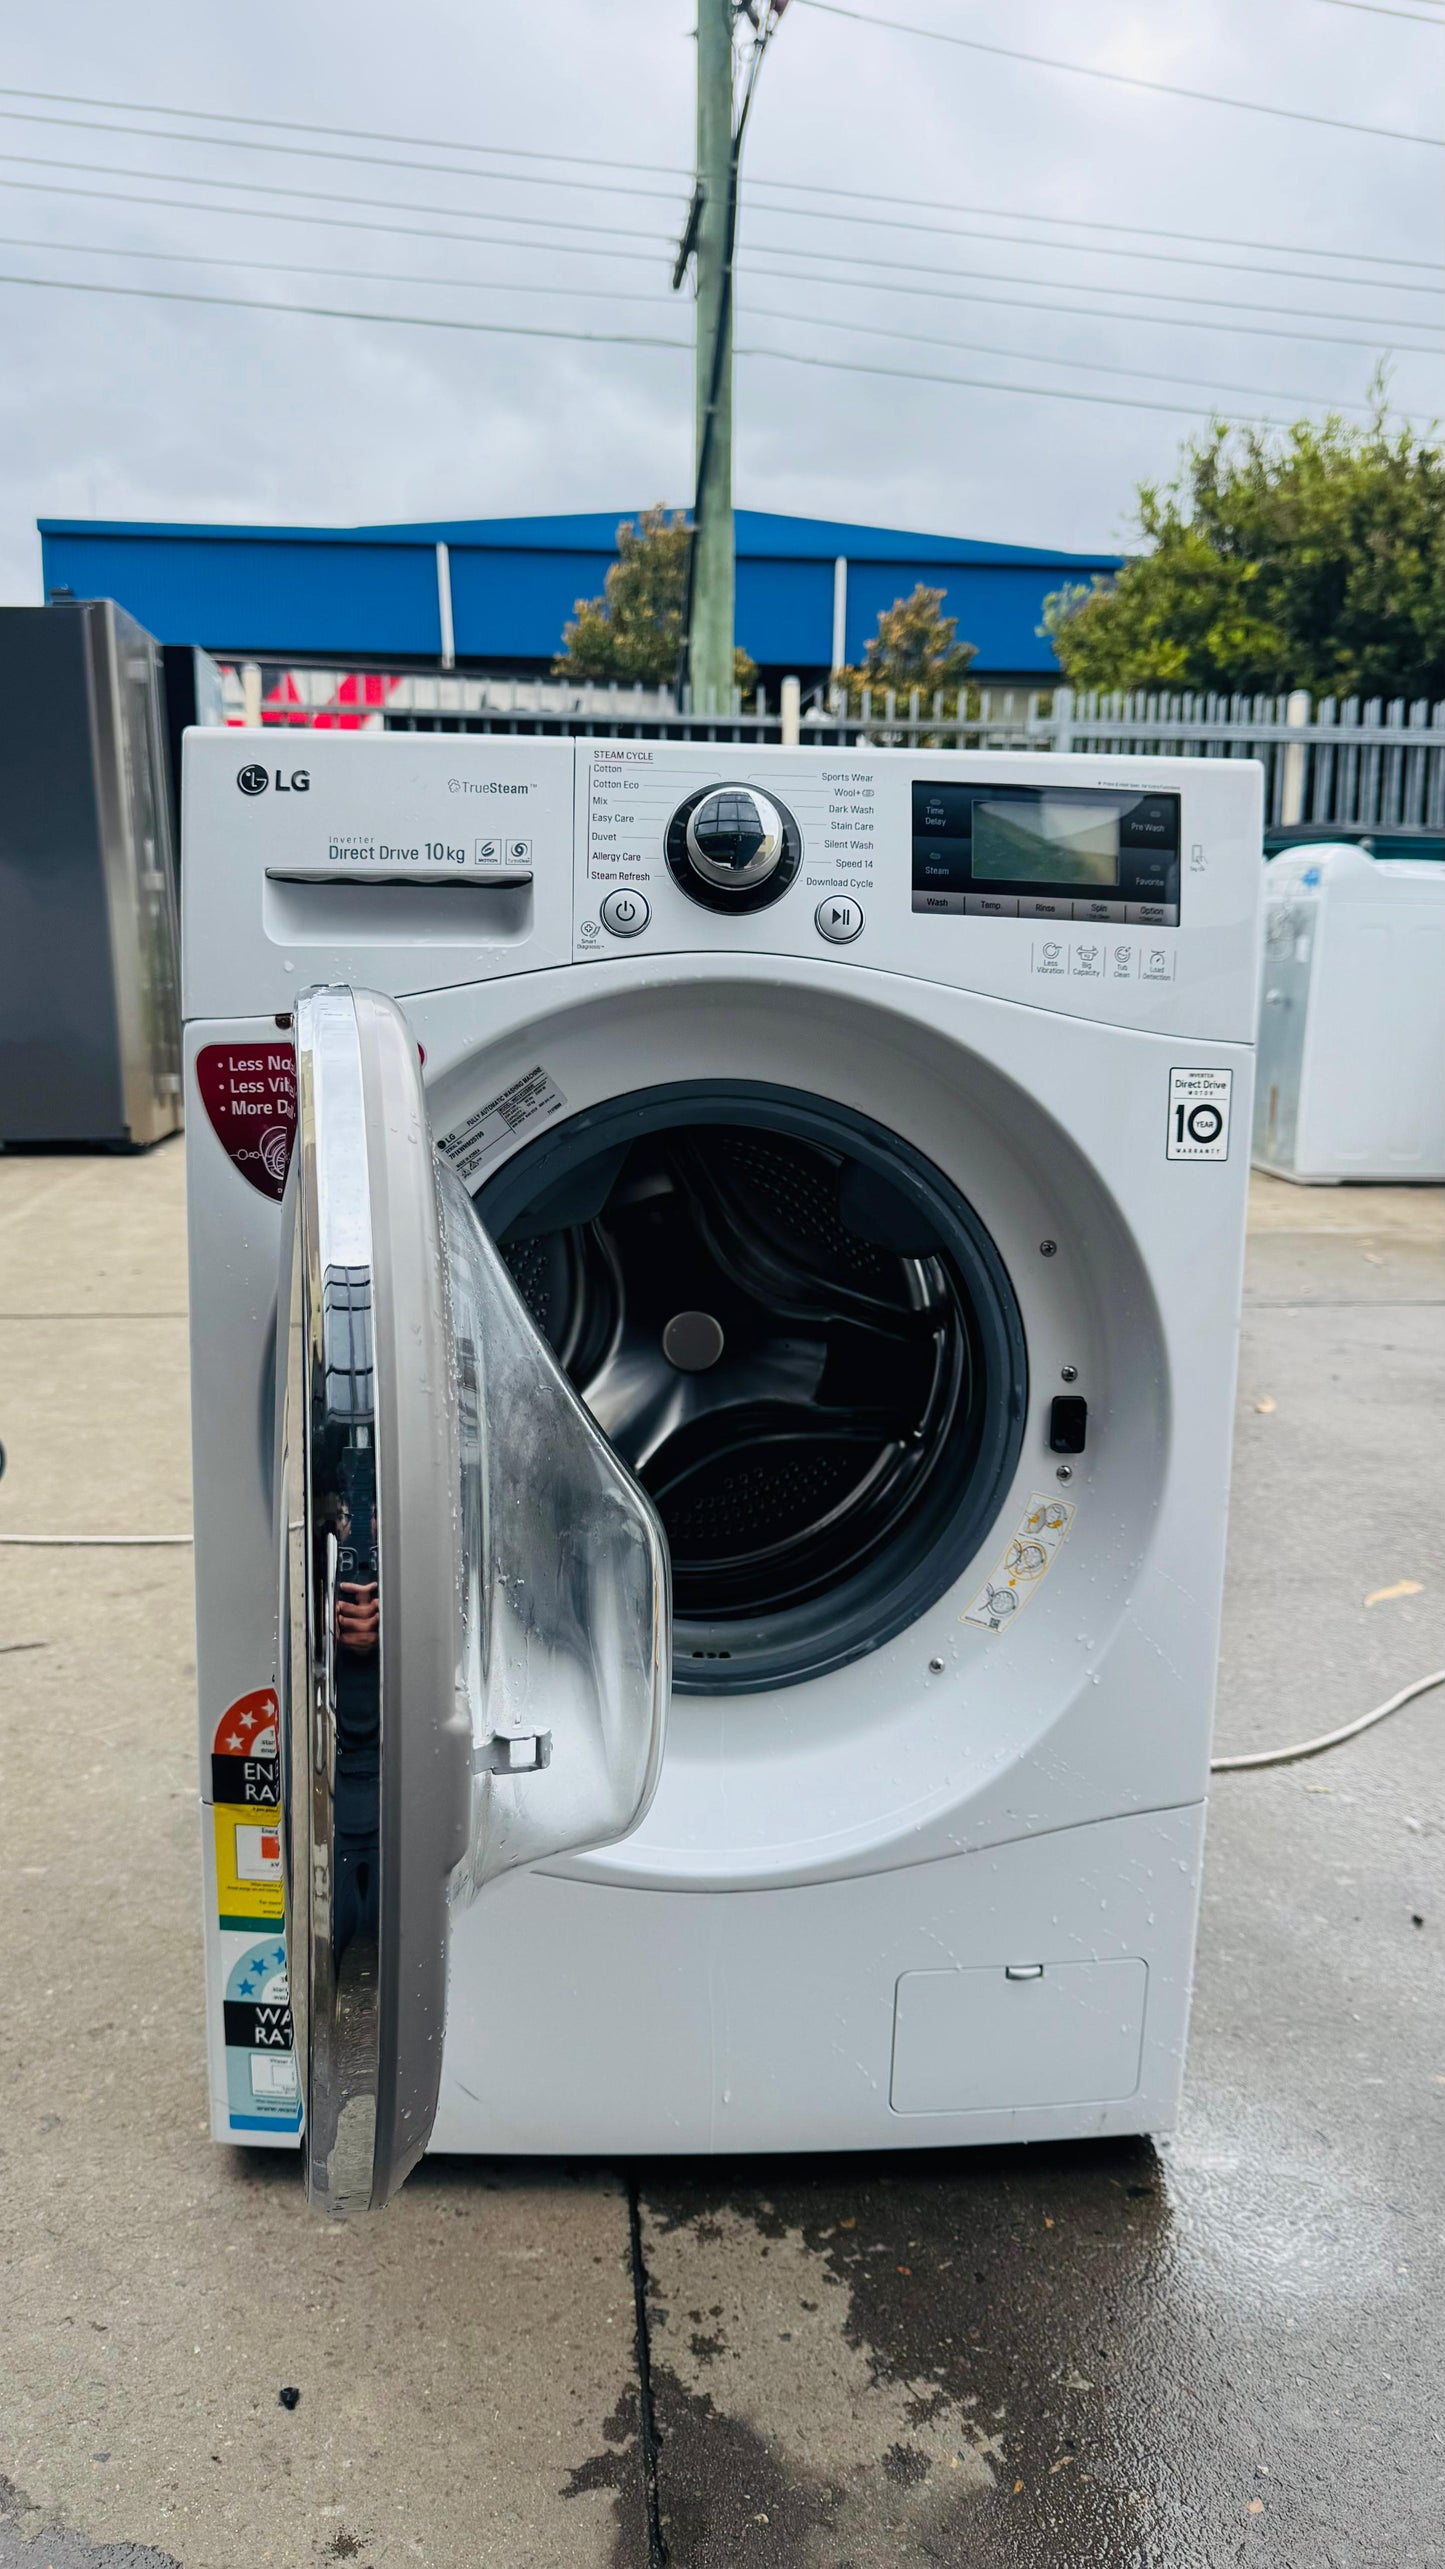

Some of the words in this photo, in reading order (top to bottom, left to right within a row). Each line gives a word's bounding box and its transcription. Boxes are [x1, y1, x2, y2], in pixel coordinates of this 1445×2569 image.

[594, 750, 624, 760] STEAM
[626, 752, 654, 760] CYCLE
[594, 764, 622, 773] Cotton
[275, 770, 310, 792] LG
[822, 773, 850, 782] Sports
[851, 774, 874, 782] Wear
[593, 780, 622, 789] Cotton
[624, 781, 639, 789] Eco
[593, 796, 608, 805] Mix
[829, 804, 848, 813] Dark
[850, 805, 874, 814] Wash
[925, 806, 945, 815] Time
[592, 813, 612, 823] Easy
[615, 814, 634, 822] Care
[925, 817, 947, 827] Delay
[831, 821, 853, 830] Stain
[854, 822, 874, 831] Care
[1131, 822, 1144, 832] Pre
[1145, 824, 1166, 832] Wash
[329, 836, 375, 844] Inverter
[592, 832, 617, 841] Duvet
[824, 840, 848, 849] Silent
[850, 840, 874, 850] Wash
[329, 845, 375, 860] Direct
[379, 846, 419, 860] Drive
[592, 851, 621, 862] Allergy
[622, 852, 641, 861] Care
[836, 859, 862, 869] Speed
[865, 860, 873, 868] 14
[925, 866, 950, 875] Steam
[591, 871, 617, 880] Steam
[619, 871, 650, 881] Refresh
[806, 877, 848, 887] Download
[850, 878, 874, 889] Cycle
[1135, 877, 1165, 887] Favorite
[926, 898, 949, 907] Wash
[1035, 903, 1056, 912] Rinse
[1091, 903, 1108, 913] Spin
[1140, 905, 1164, 915] Option
[1037, 966, 1065, 975] Vibration
[1073, 969, 1100, 977] Capacity
[229, 1057, 264, 1072] Less
[230, 1079, 265, 1094] Less
[1175, 1079, 1201, 1088] Direct
[1203, 1080, 1227, 1089] Drive
[232, 1100, 273, 1115] More
[466, 1112, 481, 1126] FULLY
[481, 1095, 505, 1117] AUTOMATIC
[1175, 1104, 1223, 1144] 10
[445, 1133, 456, 1143] LG
